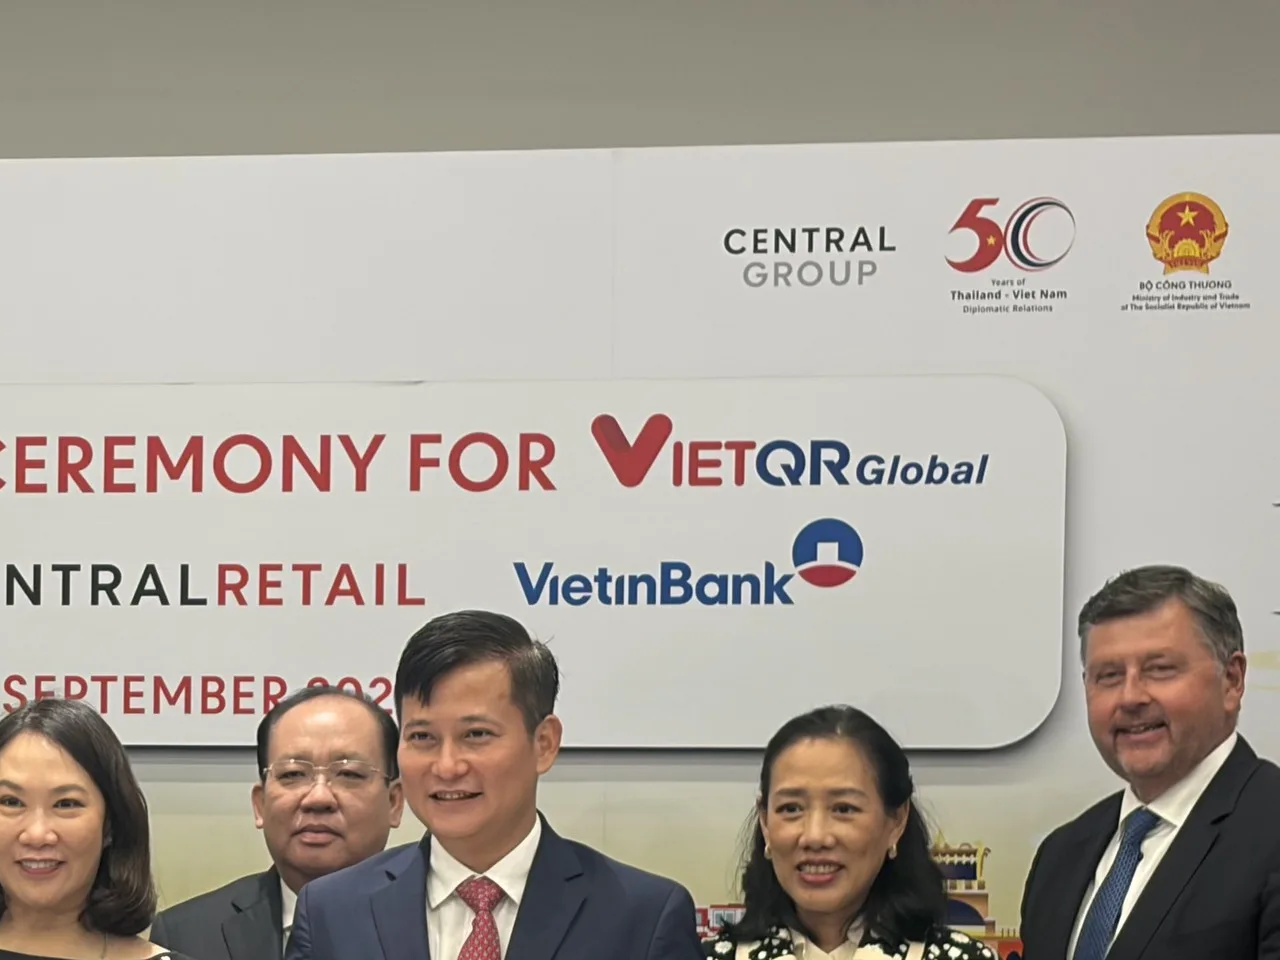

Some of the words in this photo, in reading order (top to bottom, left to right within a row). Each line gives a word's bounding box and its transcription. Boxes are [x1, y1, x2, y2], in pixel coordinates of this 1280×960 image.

[724, 226, 896, 254] CENTRAL
[944, 197, 1076, 273] 50
[743, 260, 877, 287] GROUP
[1017, 278, 1025, 286] of
[1140, 280, 1153, 292] BỘ
[1156, 280, 1186, 289] CÔNG
[951, 290, 1001, 300] Thailand
[1013, 290, 1035, 299] Viet
[1040, 290, 1067, 299] Nam
[963, 305, 1009, 314] Diplomatic
[410, 432, 556, 492] FOR
[591, 414, 850, 487] VIETQR
[856, 454, 989, 485] Global
[513, 561, 794, 606] VietinBank
[3, 675, 287, 715] SEPTEMBER
